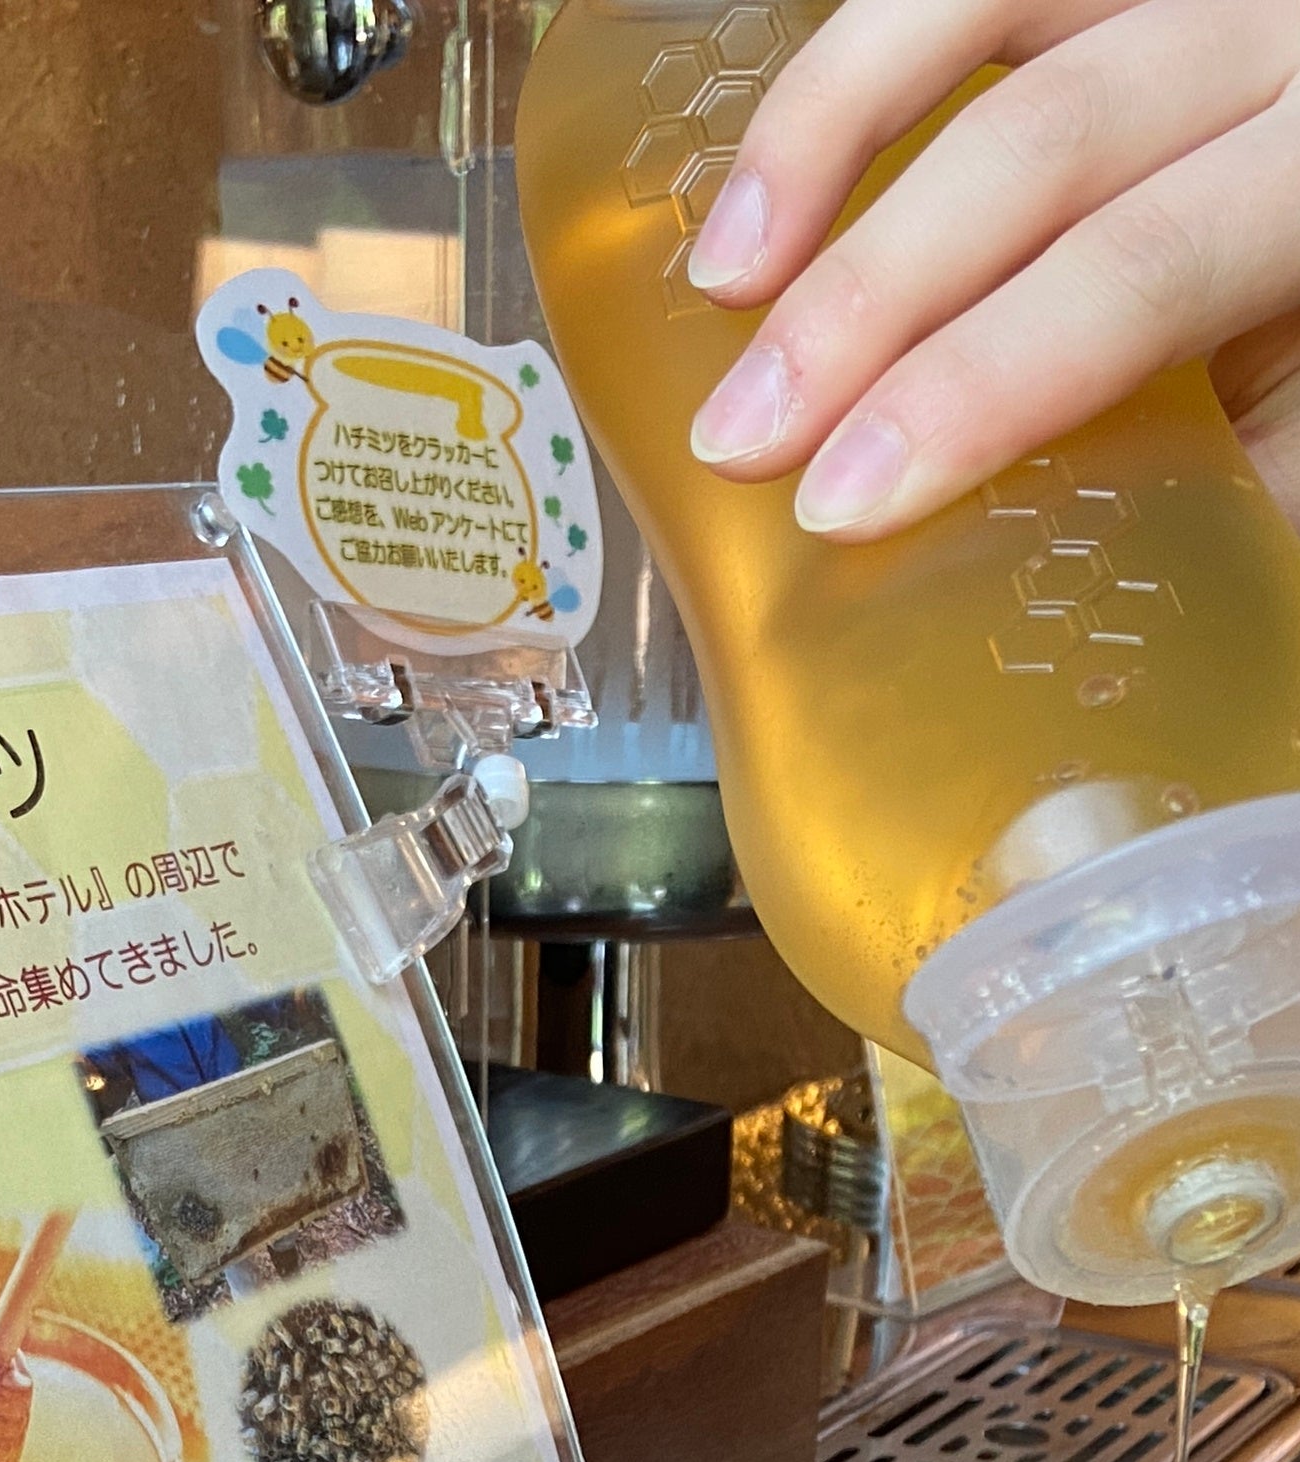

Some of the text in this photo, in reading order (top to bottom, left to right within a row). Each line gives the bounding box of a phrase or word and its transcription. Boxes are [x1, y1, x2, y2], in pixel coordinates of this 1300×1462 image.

[334, 423, 497, 469] ハチミツをクラッカーに
[313, 458, 514, 508] つけてお召し上がりください。
